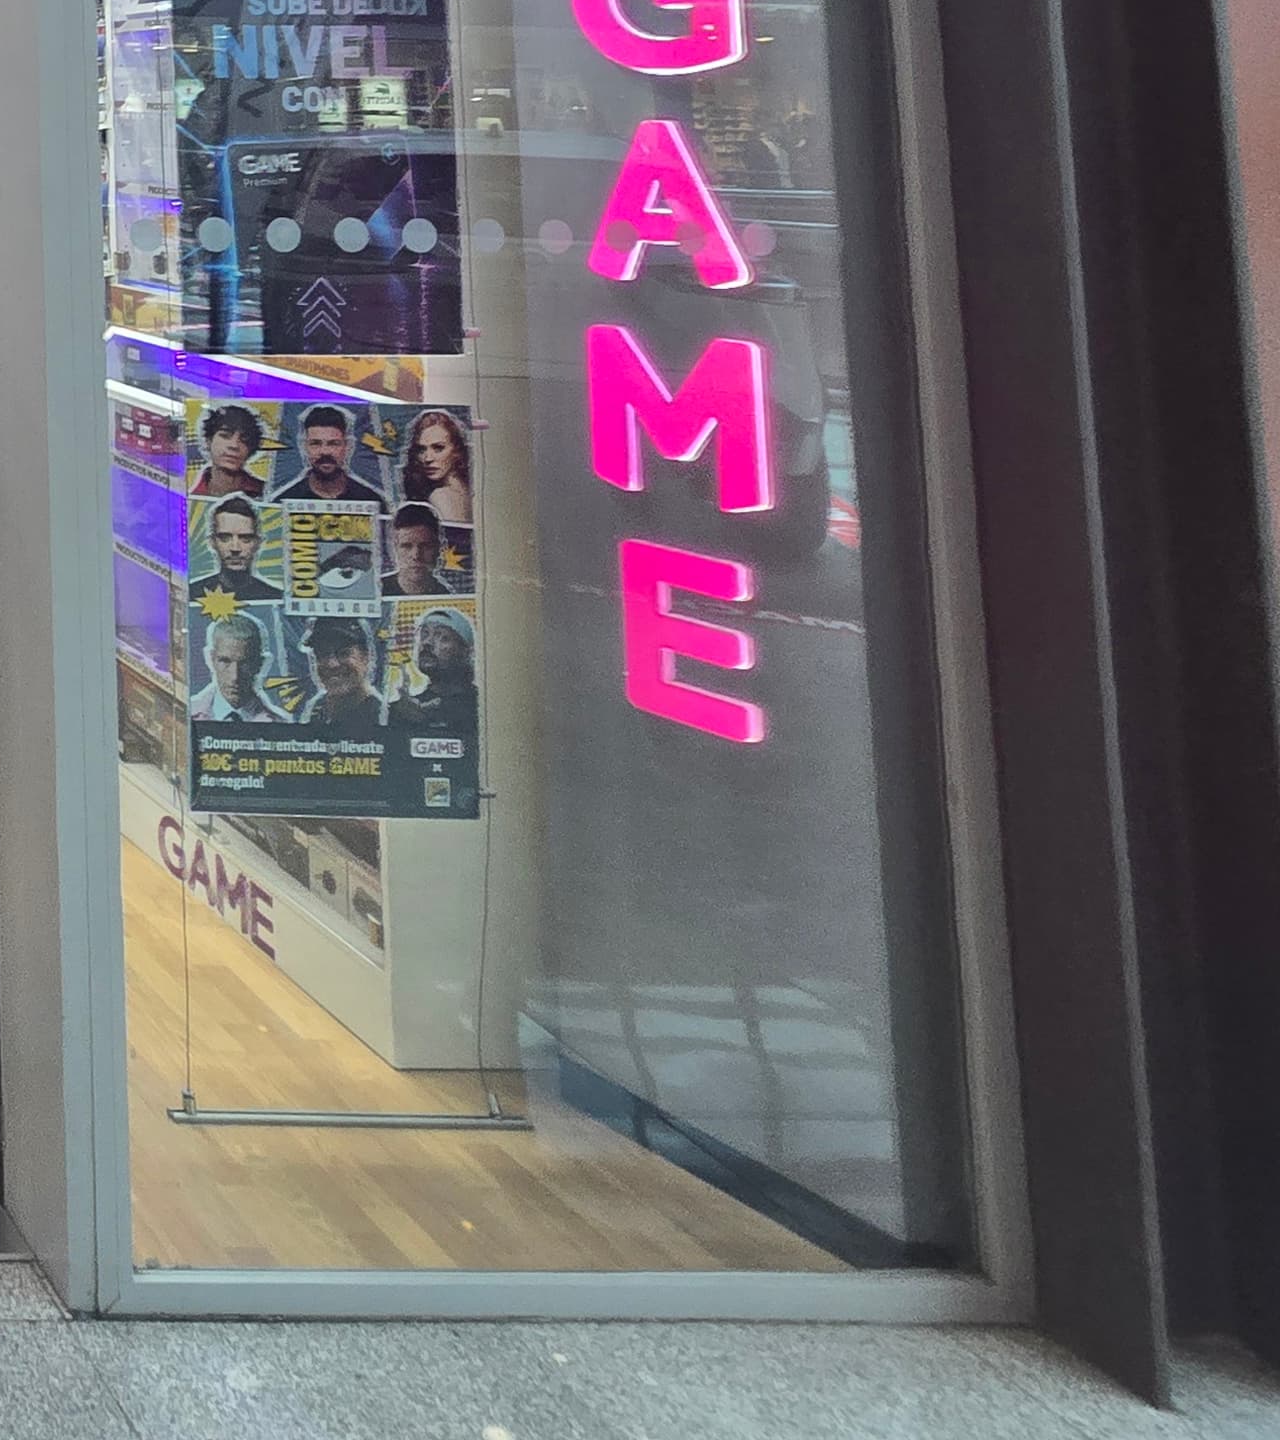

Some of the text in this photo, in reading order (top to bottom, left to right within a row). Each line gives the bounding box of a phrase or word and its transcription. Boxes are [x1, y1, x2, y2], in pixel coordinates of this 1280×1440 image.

[213, 24, 415, 80] NIVEL
[281, 86, 348, 113] CON
[239, 151, 302, 175] GAME
[243, 176, 288, 188] Premium
[318, 514, 373, 542] CON
[290, 513, 320, 598] COMIC
[416, 740, 462, 757] GAME
[237, 759, 260, 773] en
[265, 758, 326, 777] puntos
[329, 757, 382, 776] GAME
[158, 815, 276, 962] GAME
